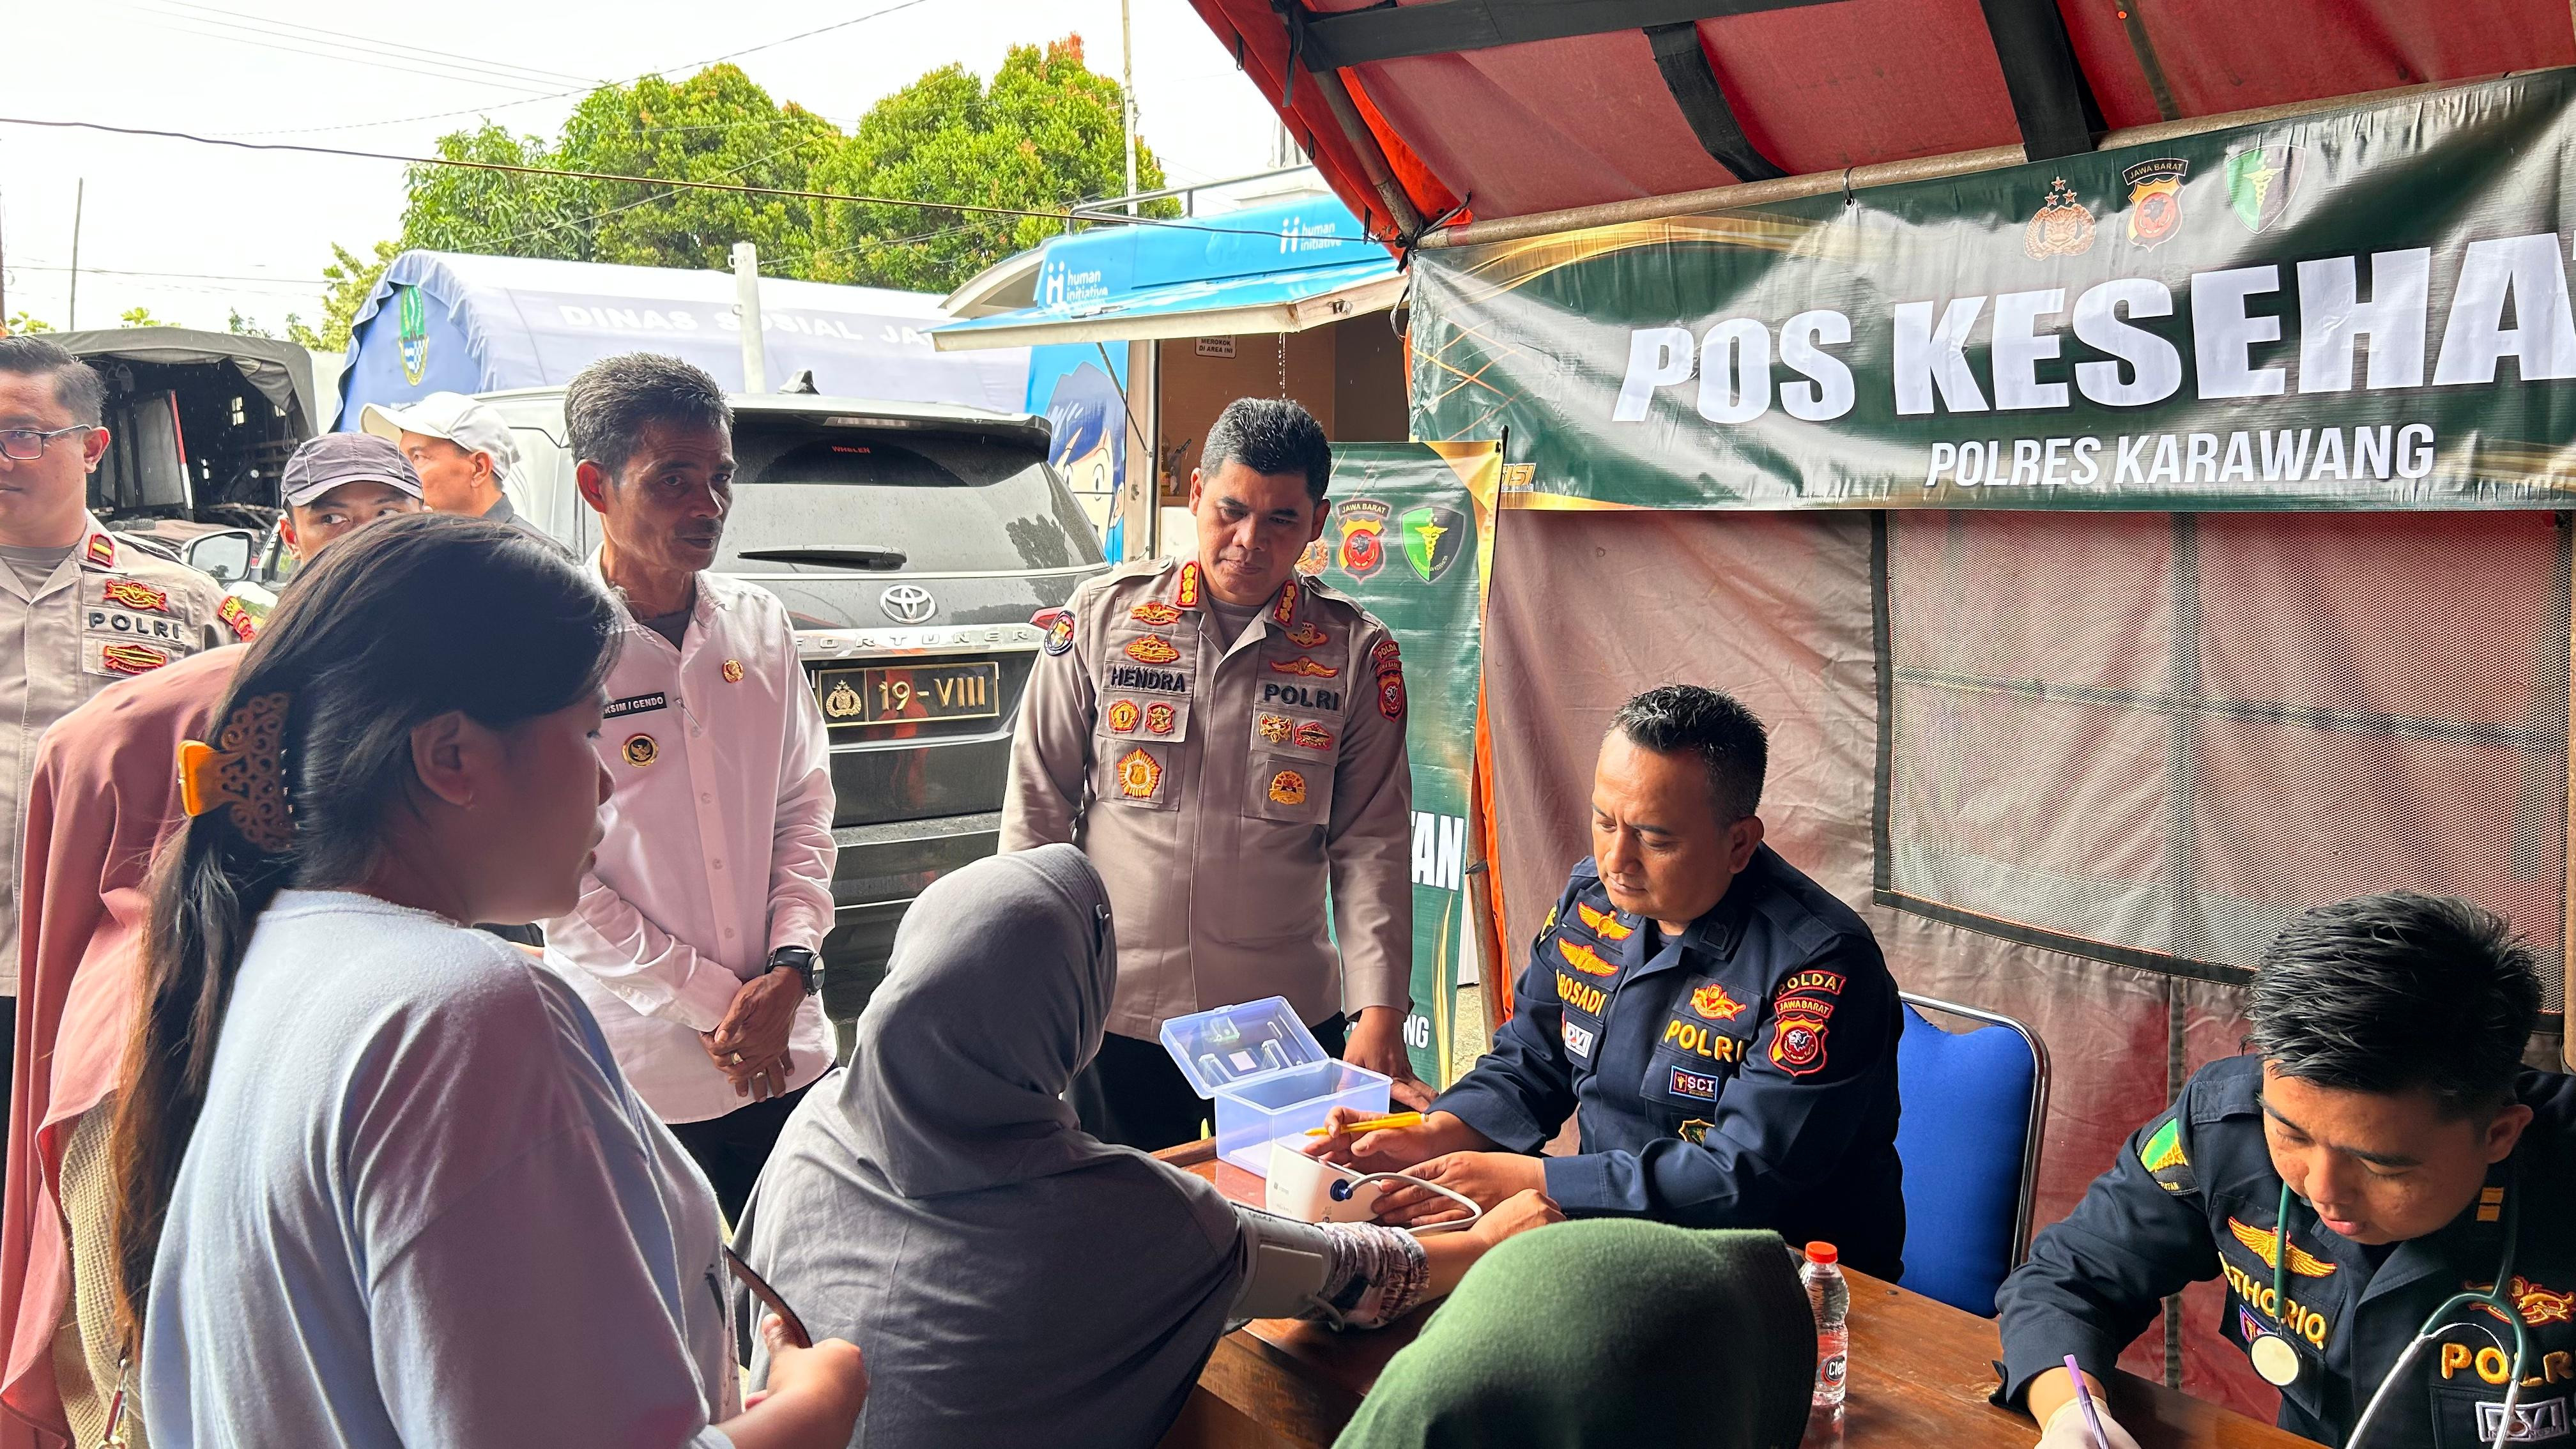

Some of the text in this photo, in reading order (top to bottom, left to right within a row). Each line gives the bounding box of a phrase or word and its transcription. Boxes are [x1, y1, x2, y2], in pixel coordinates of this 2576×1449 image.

[2129, 163, 2183, 179] JAWA BARAT
[1301, 221, 1336, 238] human
[1300, 237, 1342, 252] initiative
[1068, 268, 1101, 283] human
[1066, 284, 1108, 302] initiative
[558, 305, 700, 331] DINAS
[879, 325, 933, 347] JA
[1612, 230, 2576, 424] POS KESEHA
[1201, 338, 1231, 346] MEROKOK
[1926, 423, 2434, 487] POLRES KARAWANG
[1342, 503, 1386, 514] JAWA BARAT
[89, 612, 180, 640] POLRI
[1377, 643, 1398, 659] POLDA
[1110, 666, 1186, 693] HENDRA
[632, 696, 664, 709] GENDO
[1264, 684, 1339, 710] POLRI
[1411, 810, 1464, 891] AN
[1779, 973, 1837, 995] POLDA
[1664, 1019, 1744, 1062] POLRI
[1687, 1076, 1715, 1092] SCI
[2441, 1342, 2576, 1387] POR
